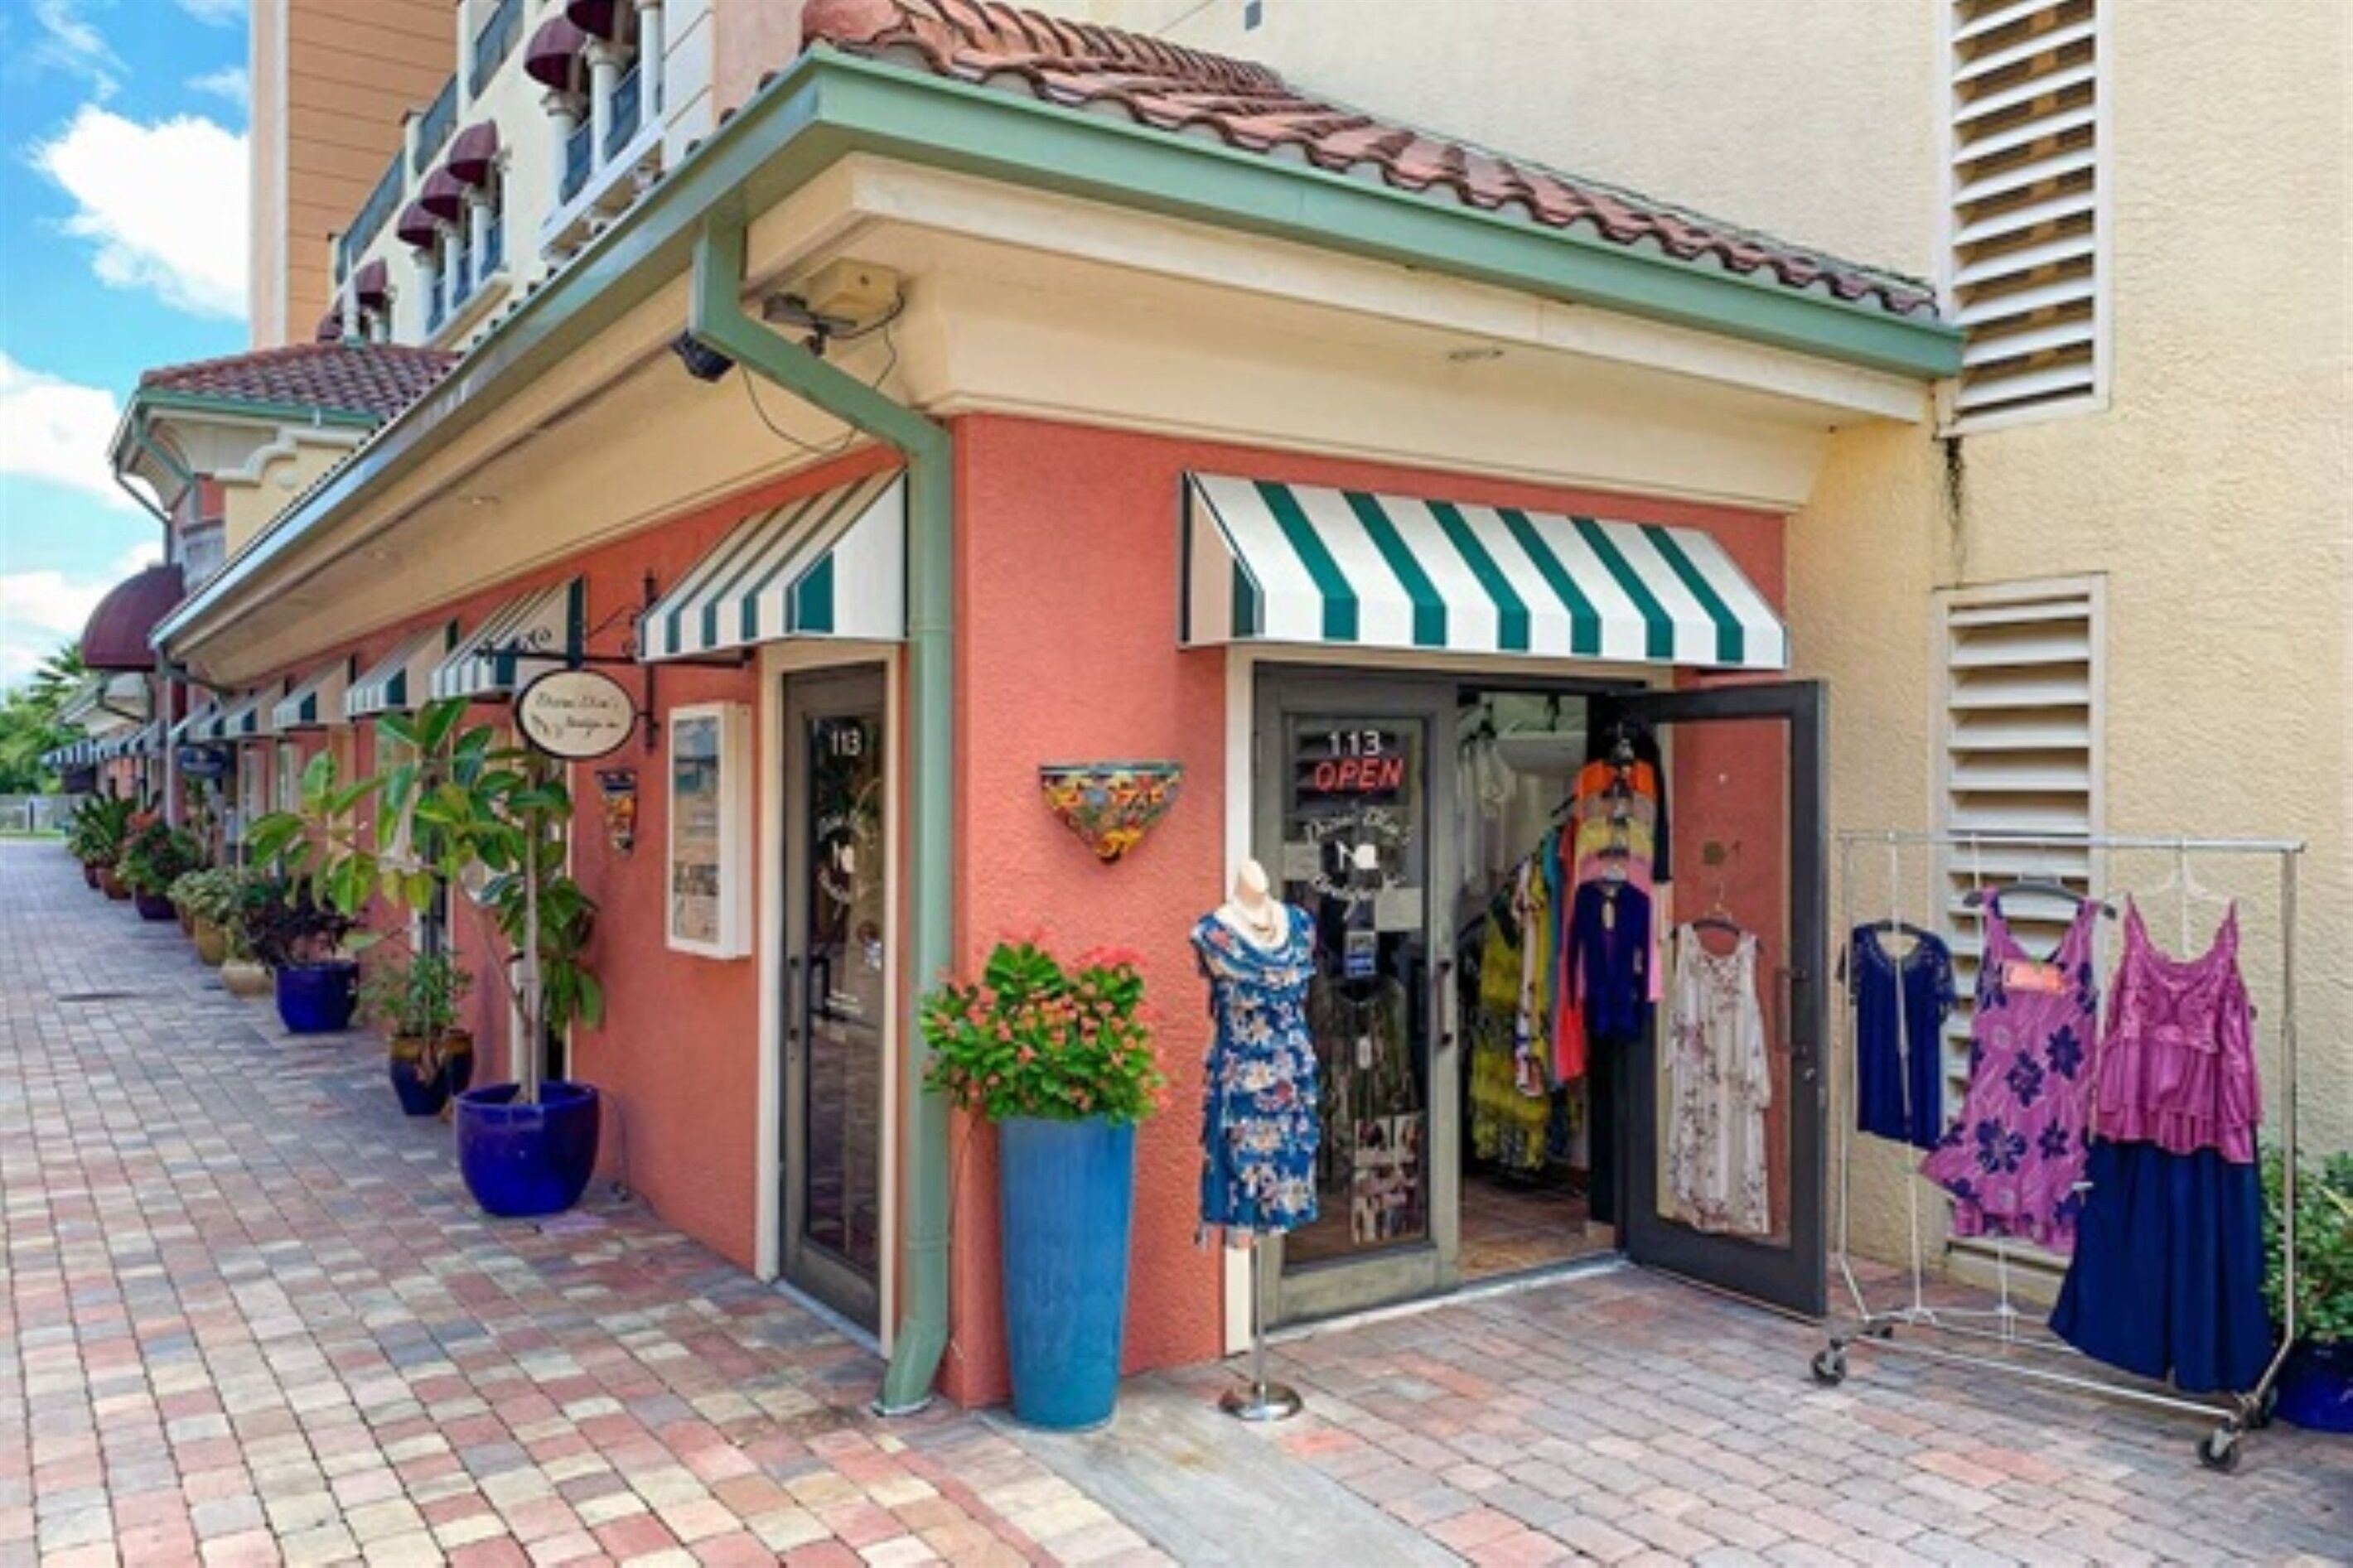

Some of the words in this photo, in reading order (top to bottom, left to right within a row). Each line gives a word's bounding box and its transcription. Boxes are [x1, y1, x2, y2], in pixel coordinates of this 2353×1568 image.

[832, 728, 862, 755] 113
[1328, 731, 1380, 755] 113
[1315, 757, 1404, 792] OPEN
